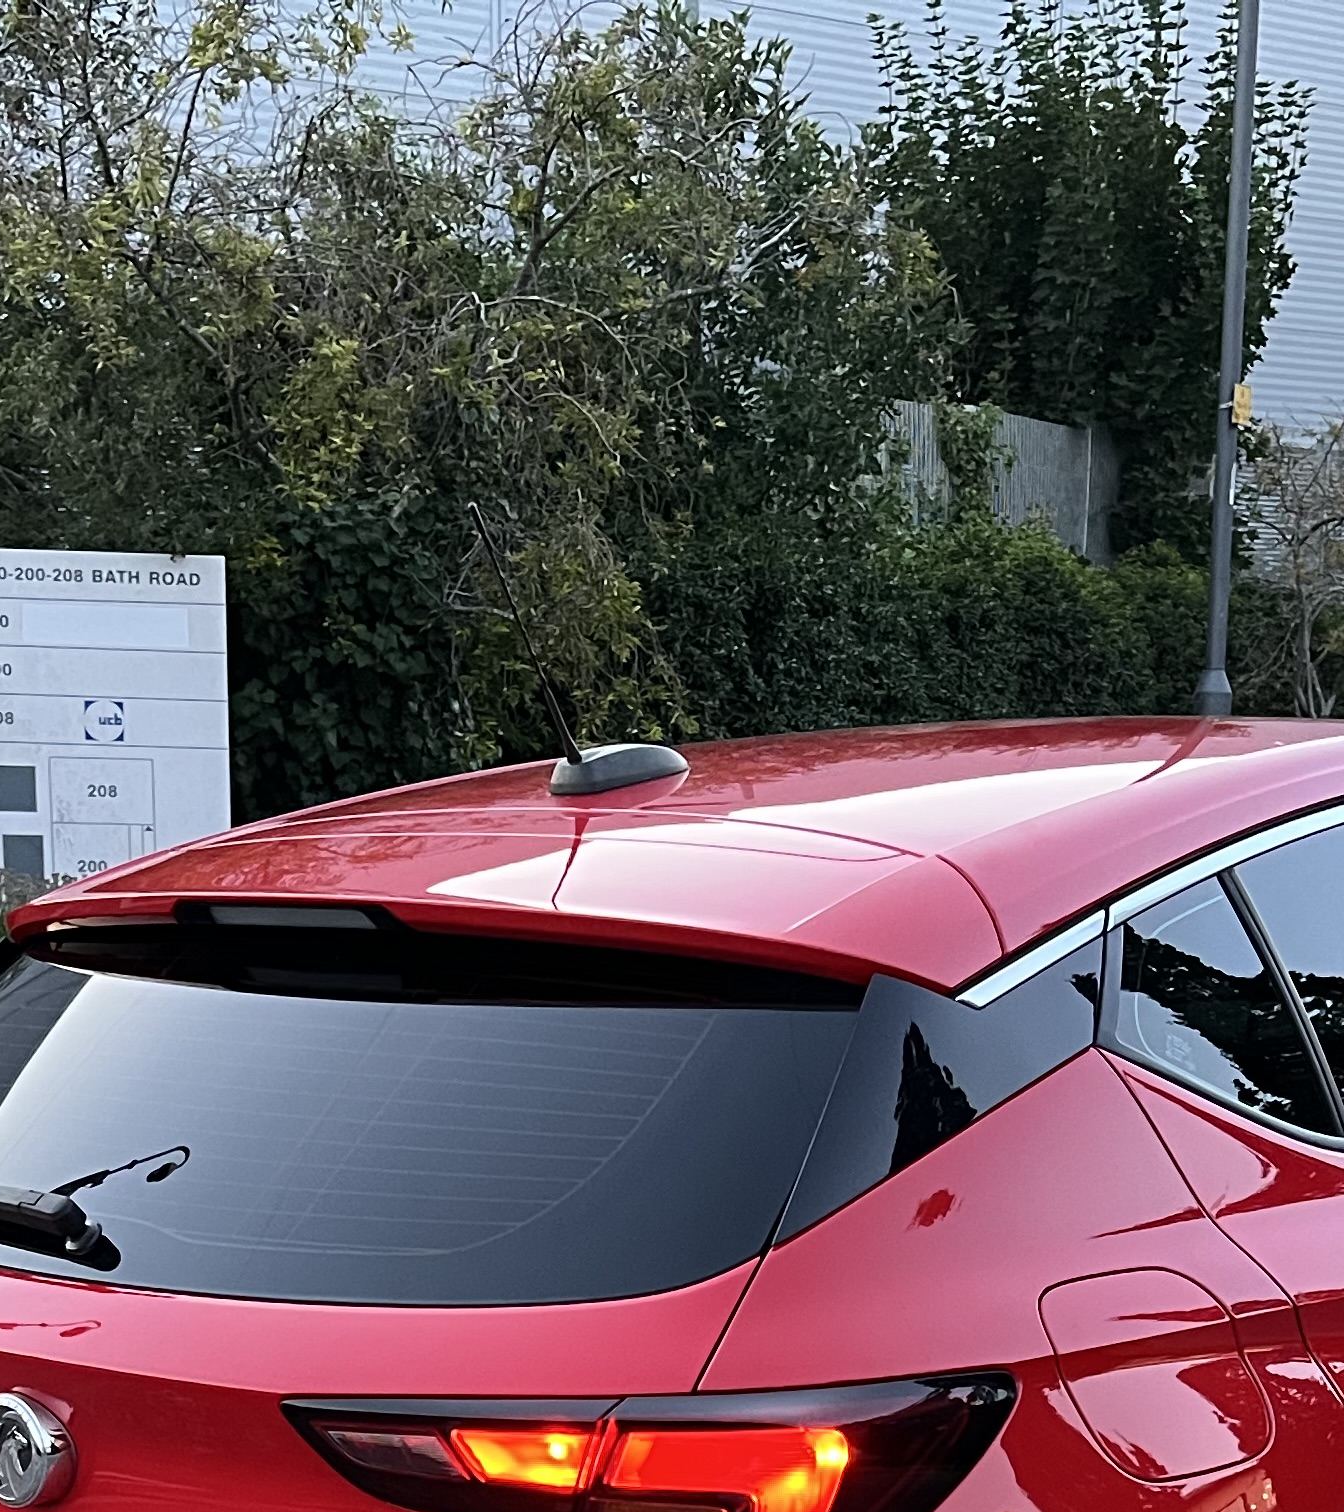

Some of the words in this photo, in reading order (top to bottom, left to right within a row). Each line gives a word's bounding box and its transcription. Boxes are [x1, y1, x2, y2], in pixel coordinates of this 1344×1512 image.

[92, 569, 141, 585] BATH
[149, 571, 201, 586] ROAD
[98, 712, 123, 726] ucb
[87, 784, 118, 798] 208
[77, 859, 108, 873] 200
